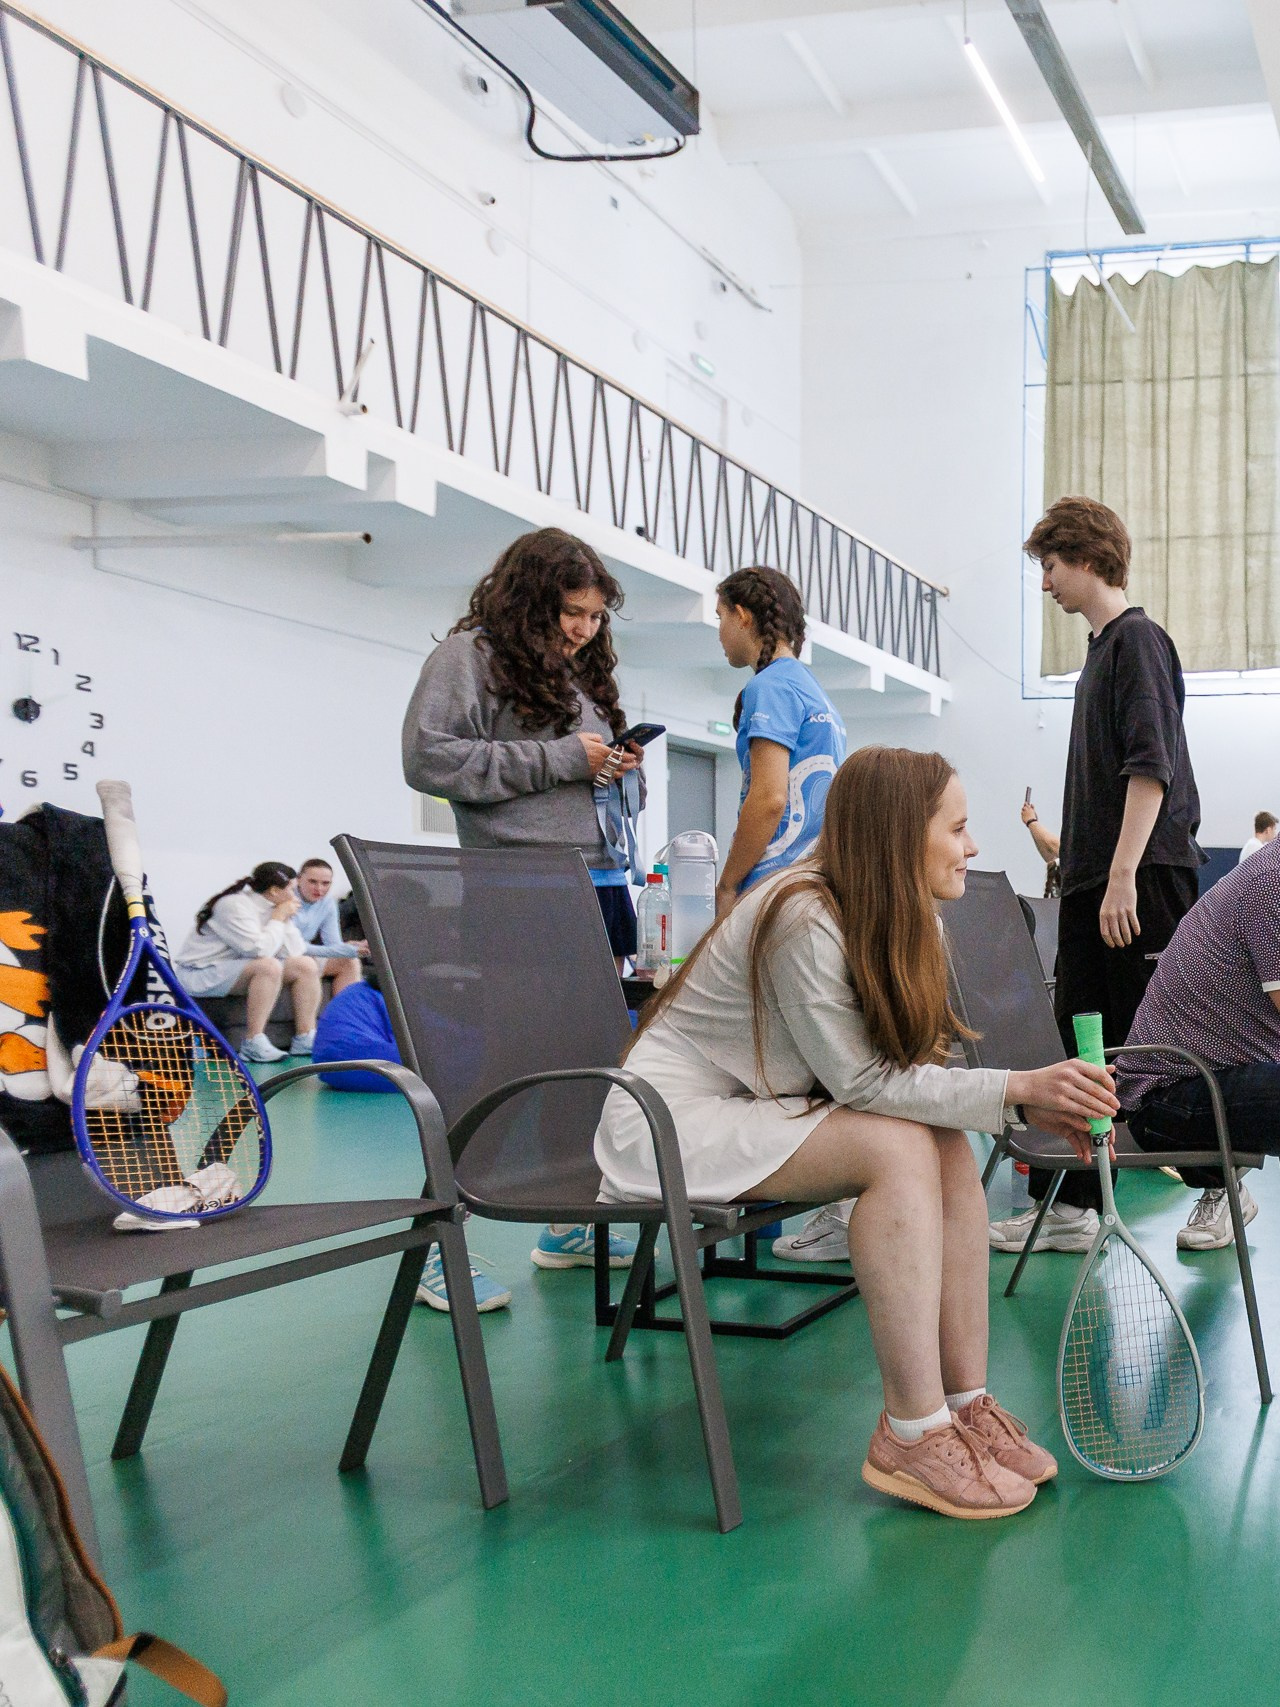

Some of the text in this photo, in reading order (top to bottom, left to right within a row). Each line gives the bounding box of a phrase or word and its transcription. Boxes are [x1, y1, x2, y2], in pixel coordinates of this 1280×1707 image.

[14, 632, 41, 652] 12
[51, 648, 60, 666] 1
[75, 674, 92, 692] 2
[90, 712, 104, 729] 3
[81, 741, 95, 757] 4
[21, 770, 38, 787] 6
[63, 763, 79, 780] 5
